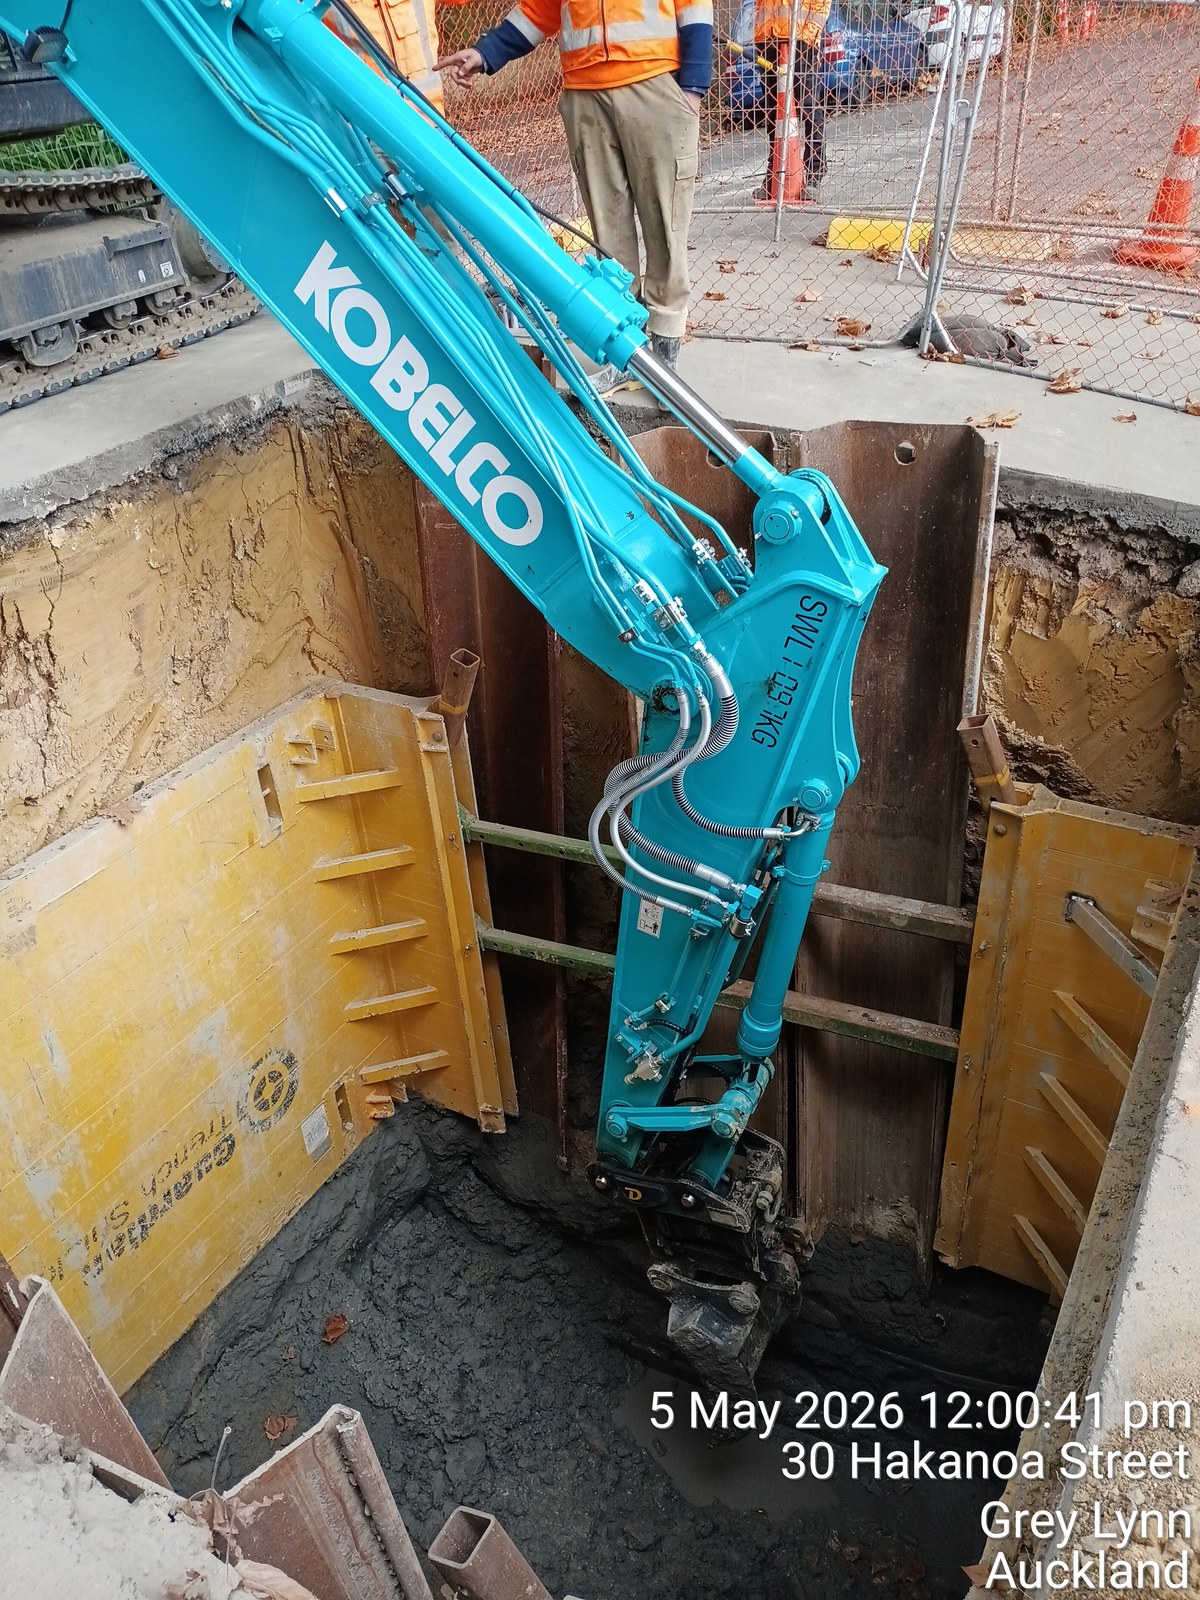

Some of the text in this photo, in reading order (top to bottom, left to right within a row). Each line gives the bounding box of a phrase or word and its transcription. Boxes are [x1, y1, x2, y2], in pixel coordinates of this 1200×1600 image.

[293, 239, 544, 546] KOBELCO
[784, 595, 828, 649] SWL
[82, 1133, 236, 1286] Guardian
[141, 1109, 232, 1198] Trench
